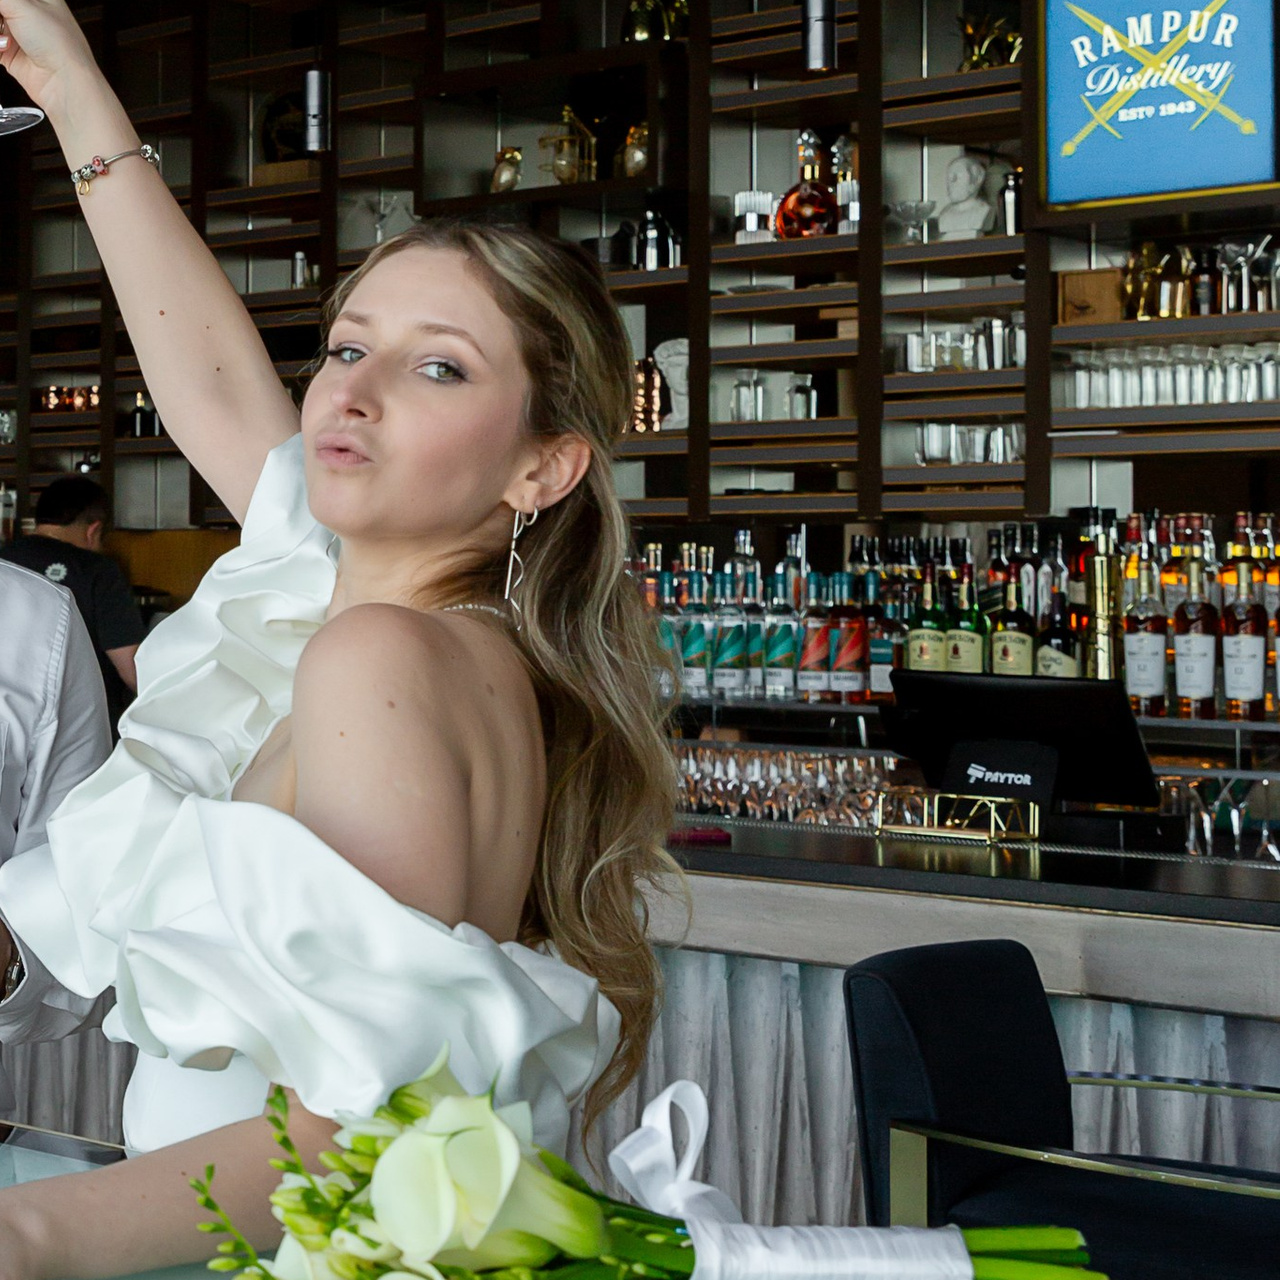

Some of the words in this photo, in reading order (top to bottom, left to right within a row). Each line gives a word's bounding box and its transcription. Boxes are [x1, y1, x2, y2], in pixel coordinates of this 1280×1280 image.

[1071, 10, 1239, 68] RAMPUR
[1085, 53, 1233, 97] Distillery
[984, 771, 1031, 786] PAYTOR
